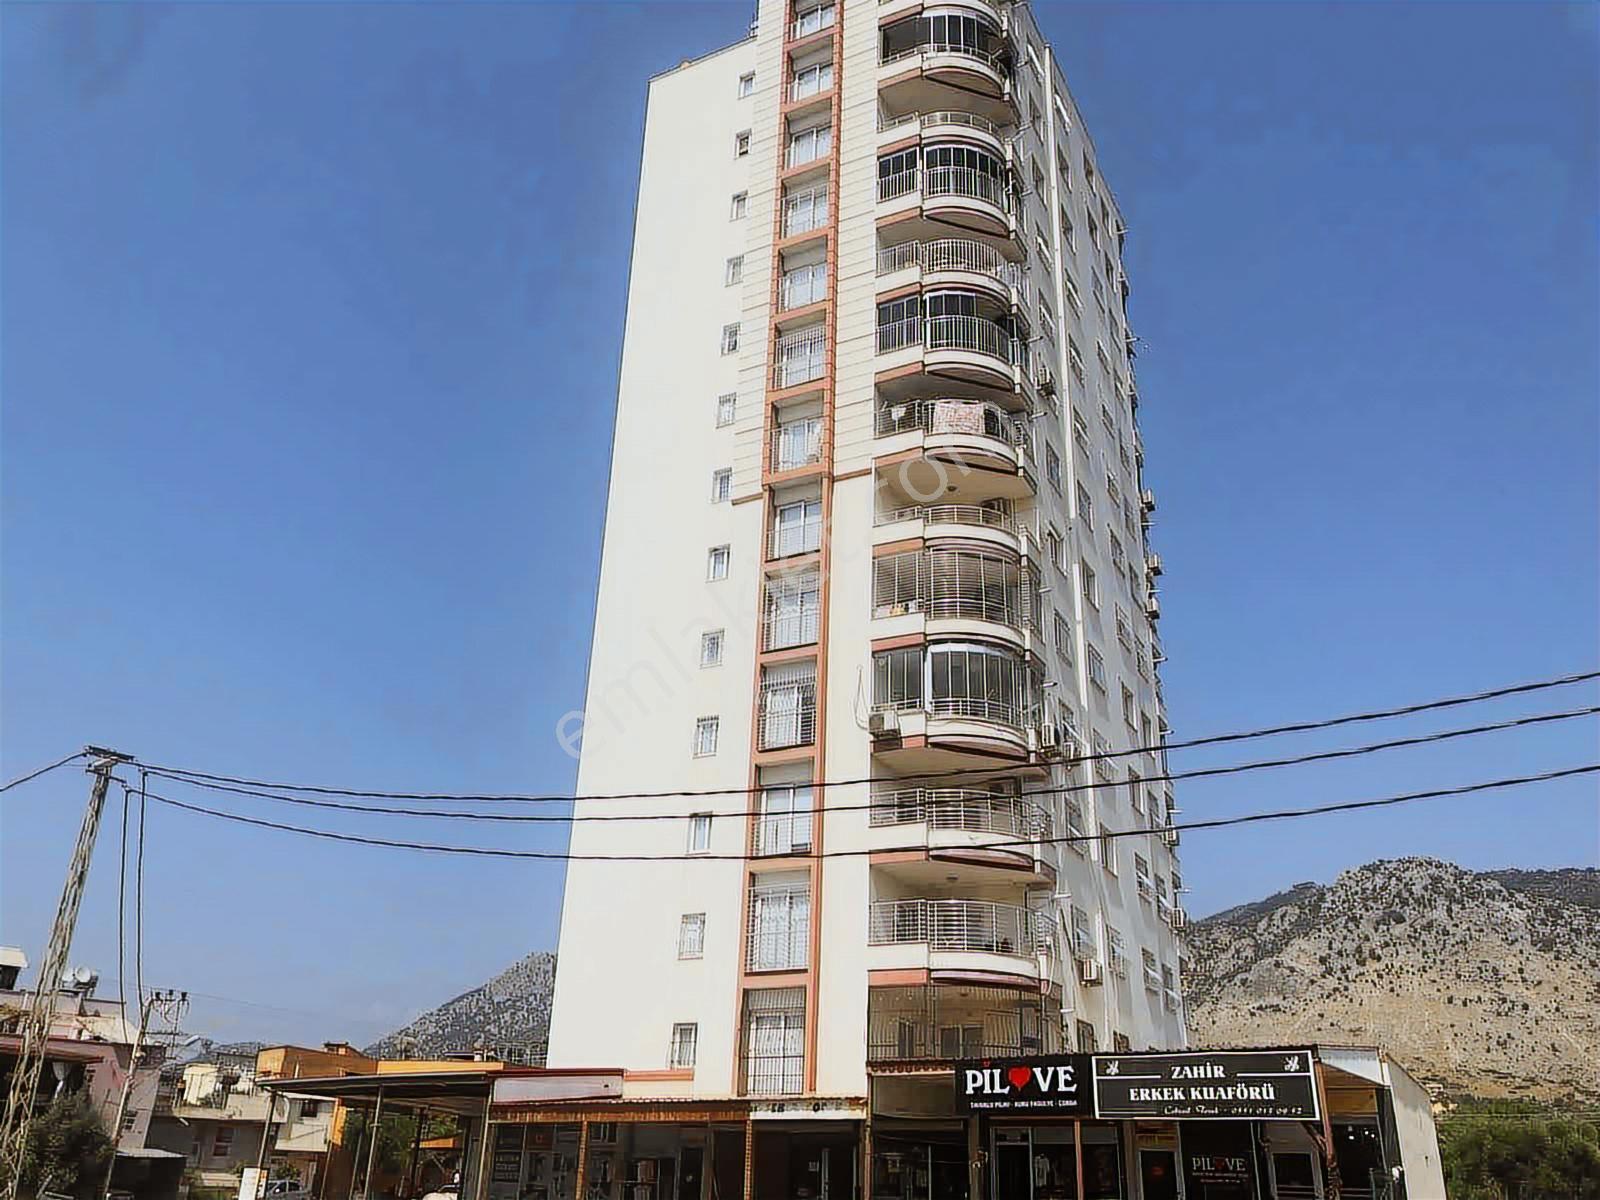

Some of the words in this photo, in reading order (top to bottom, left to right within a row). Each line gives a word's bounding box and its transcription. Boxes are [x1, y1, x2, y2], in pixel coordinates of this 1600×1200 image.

[1171, 1062, 1226, 1079] ZAHİR
[1129, 1087, 1186, 1101] ERKEK
[1190, 1083, 1275, 1101] KUAFÖRÜ
